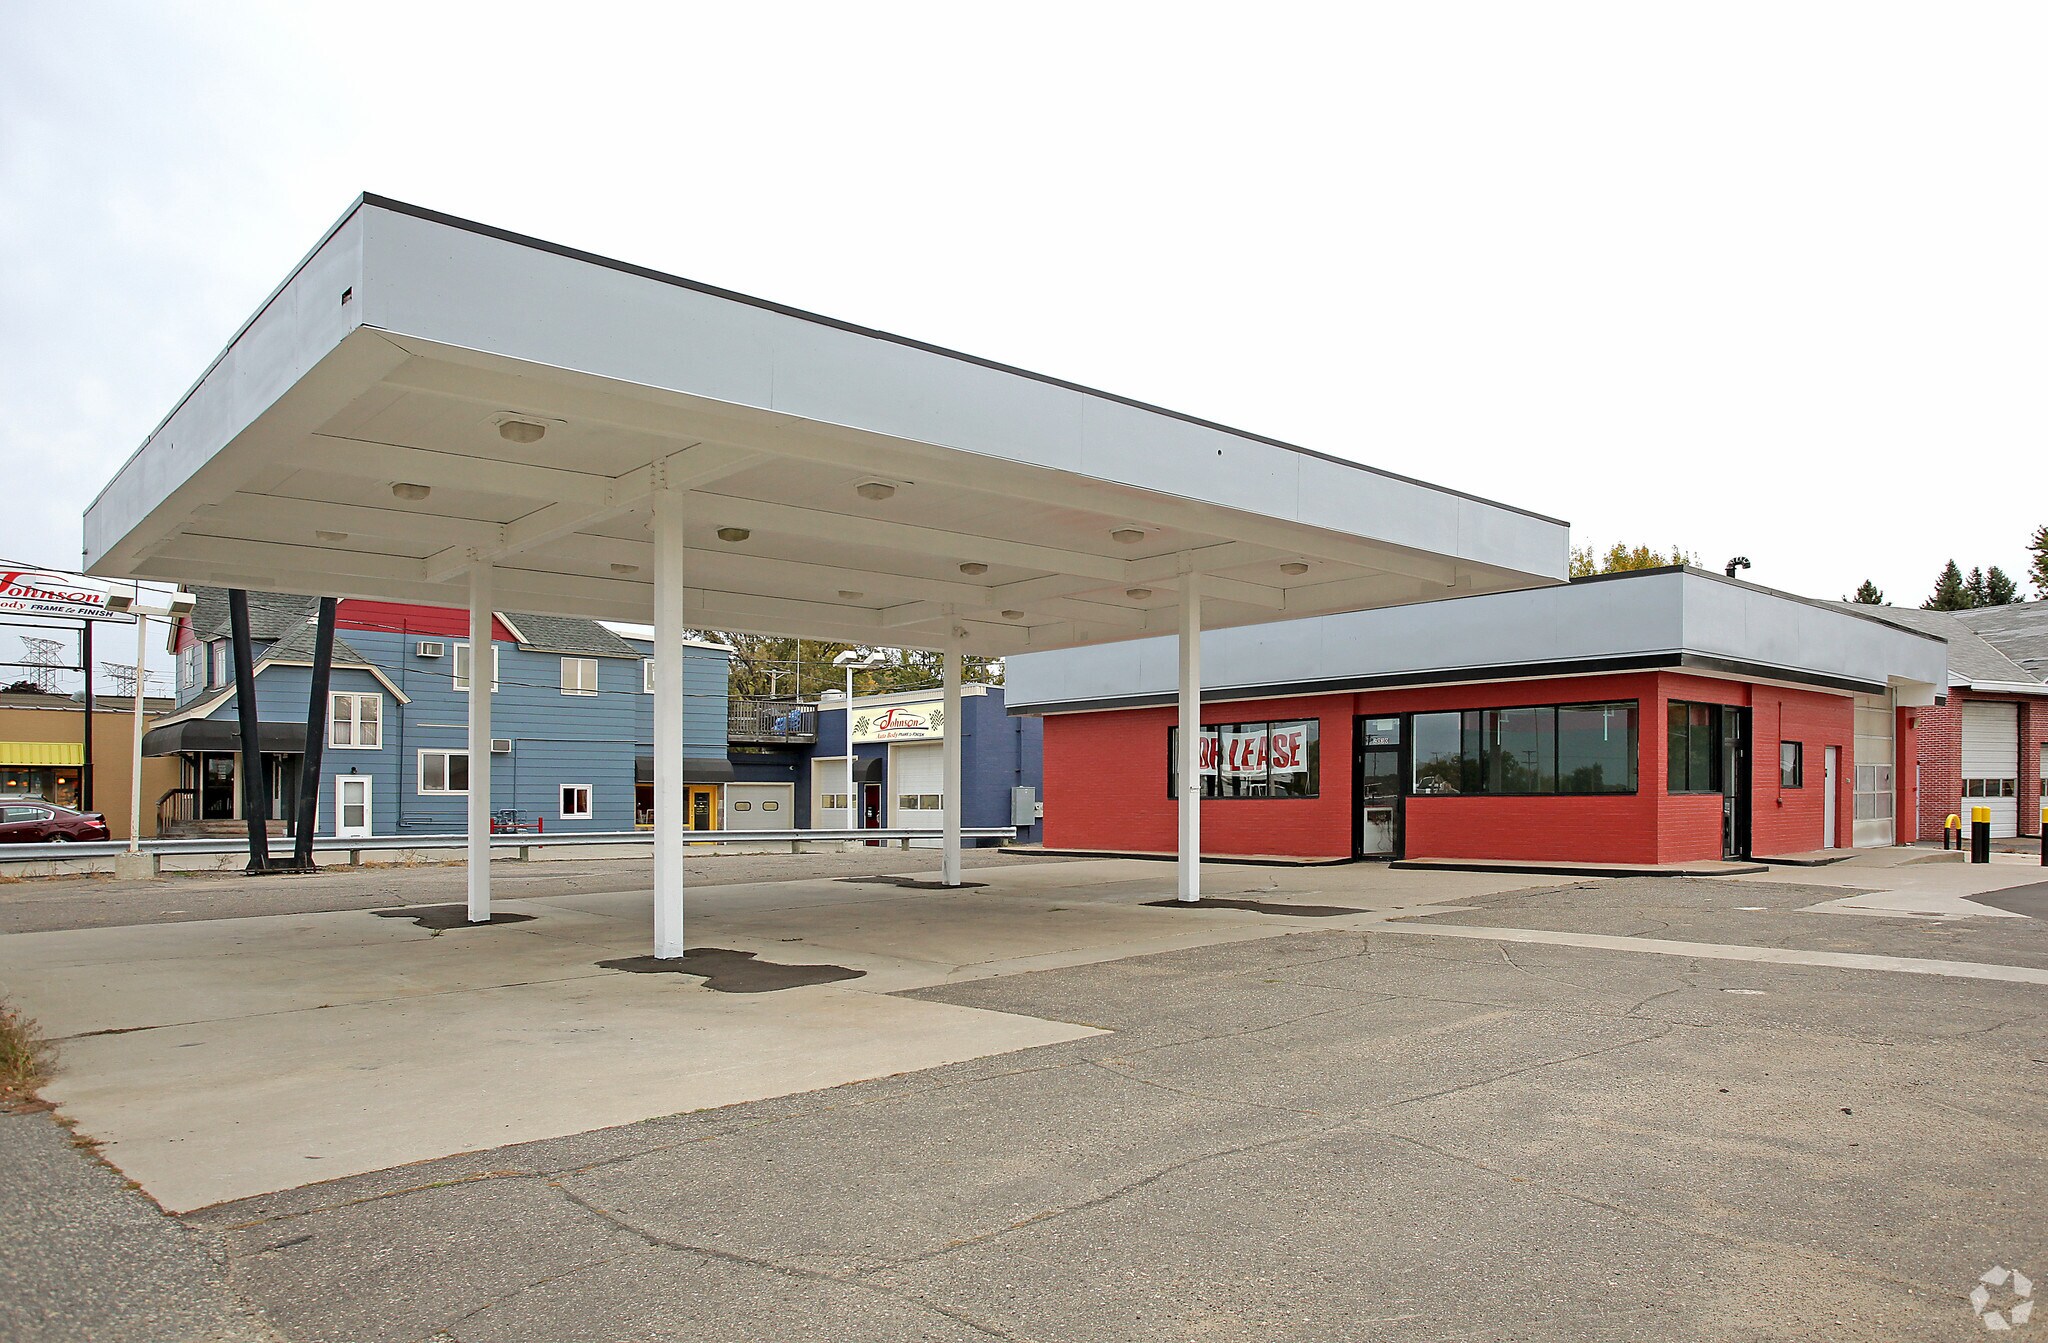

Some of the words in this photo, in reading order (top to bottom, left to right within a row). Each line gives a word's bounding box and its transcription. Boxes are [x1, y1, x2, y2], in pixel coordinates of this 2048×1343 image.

[0, 601, 26, 610] ody
[31, 604, 64, 613] FRAME
[78, 608, 114, 618] FINISH
[879, 708, 919, 730] Johnson
[1229, 732, 1301, 771] LEASE
